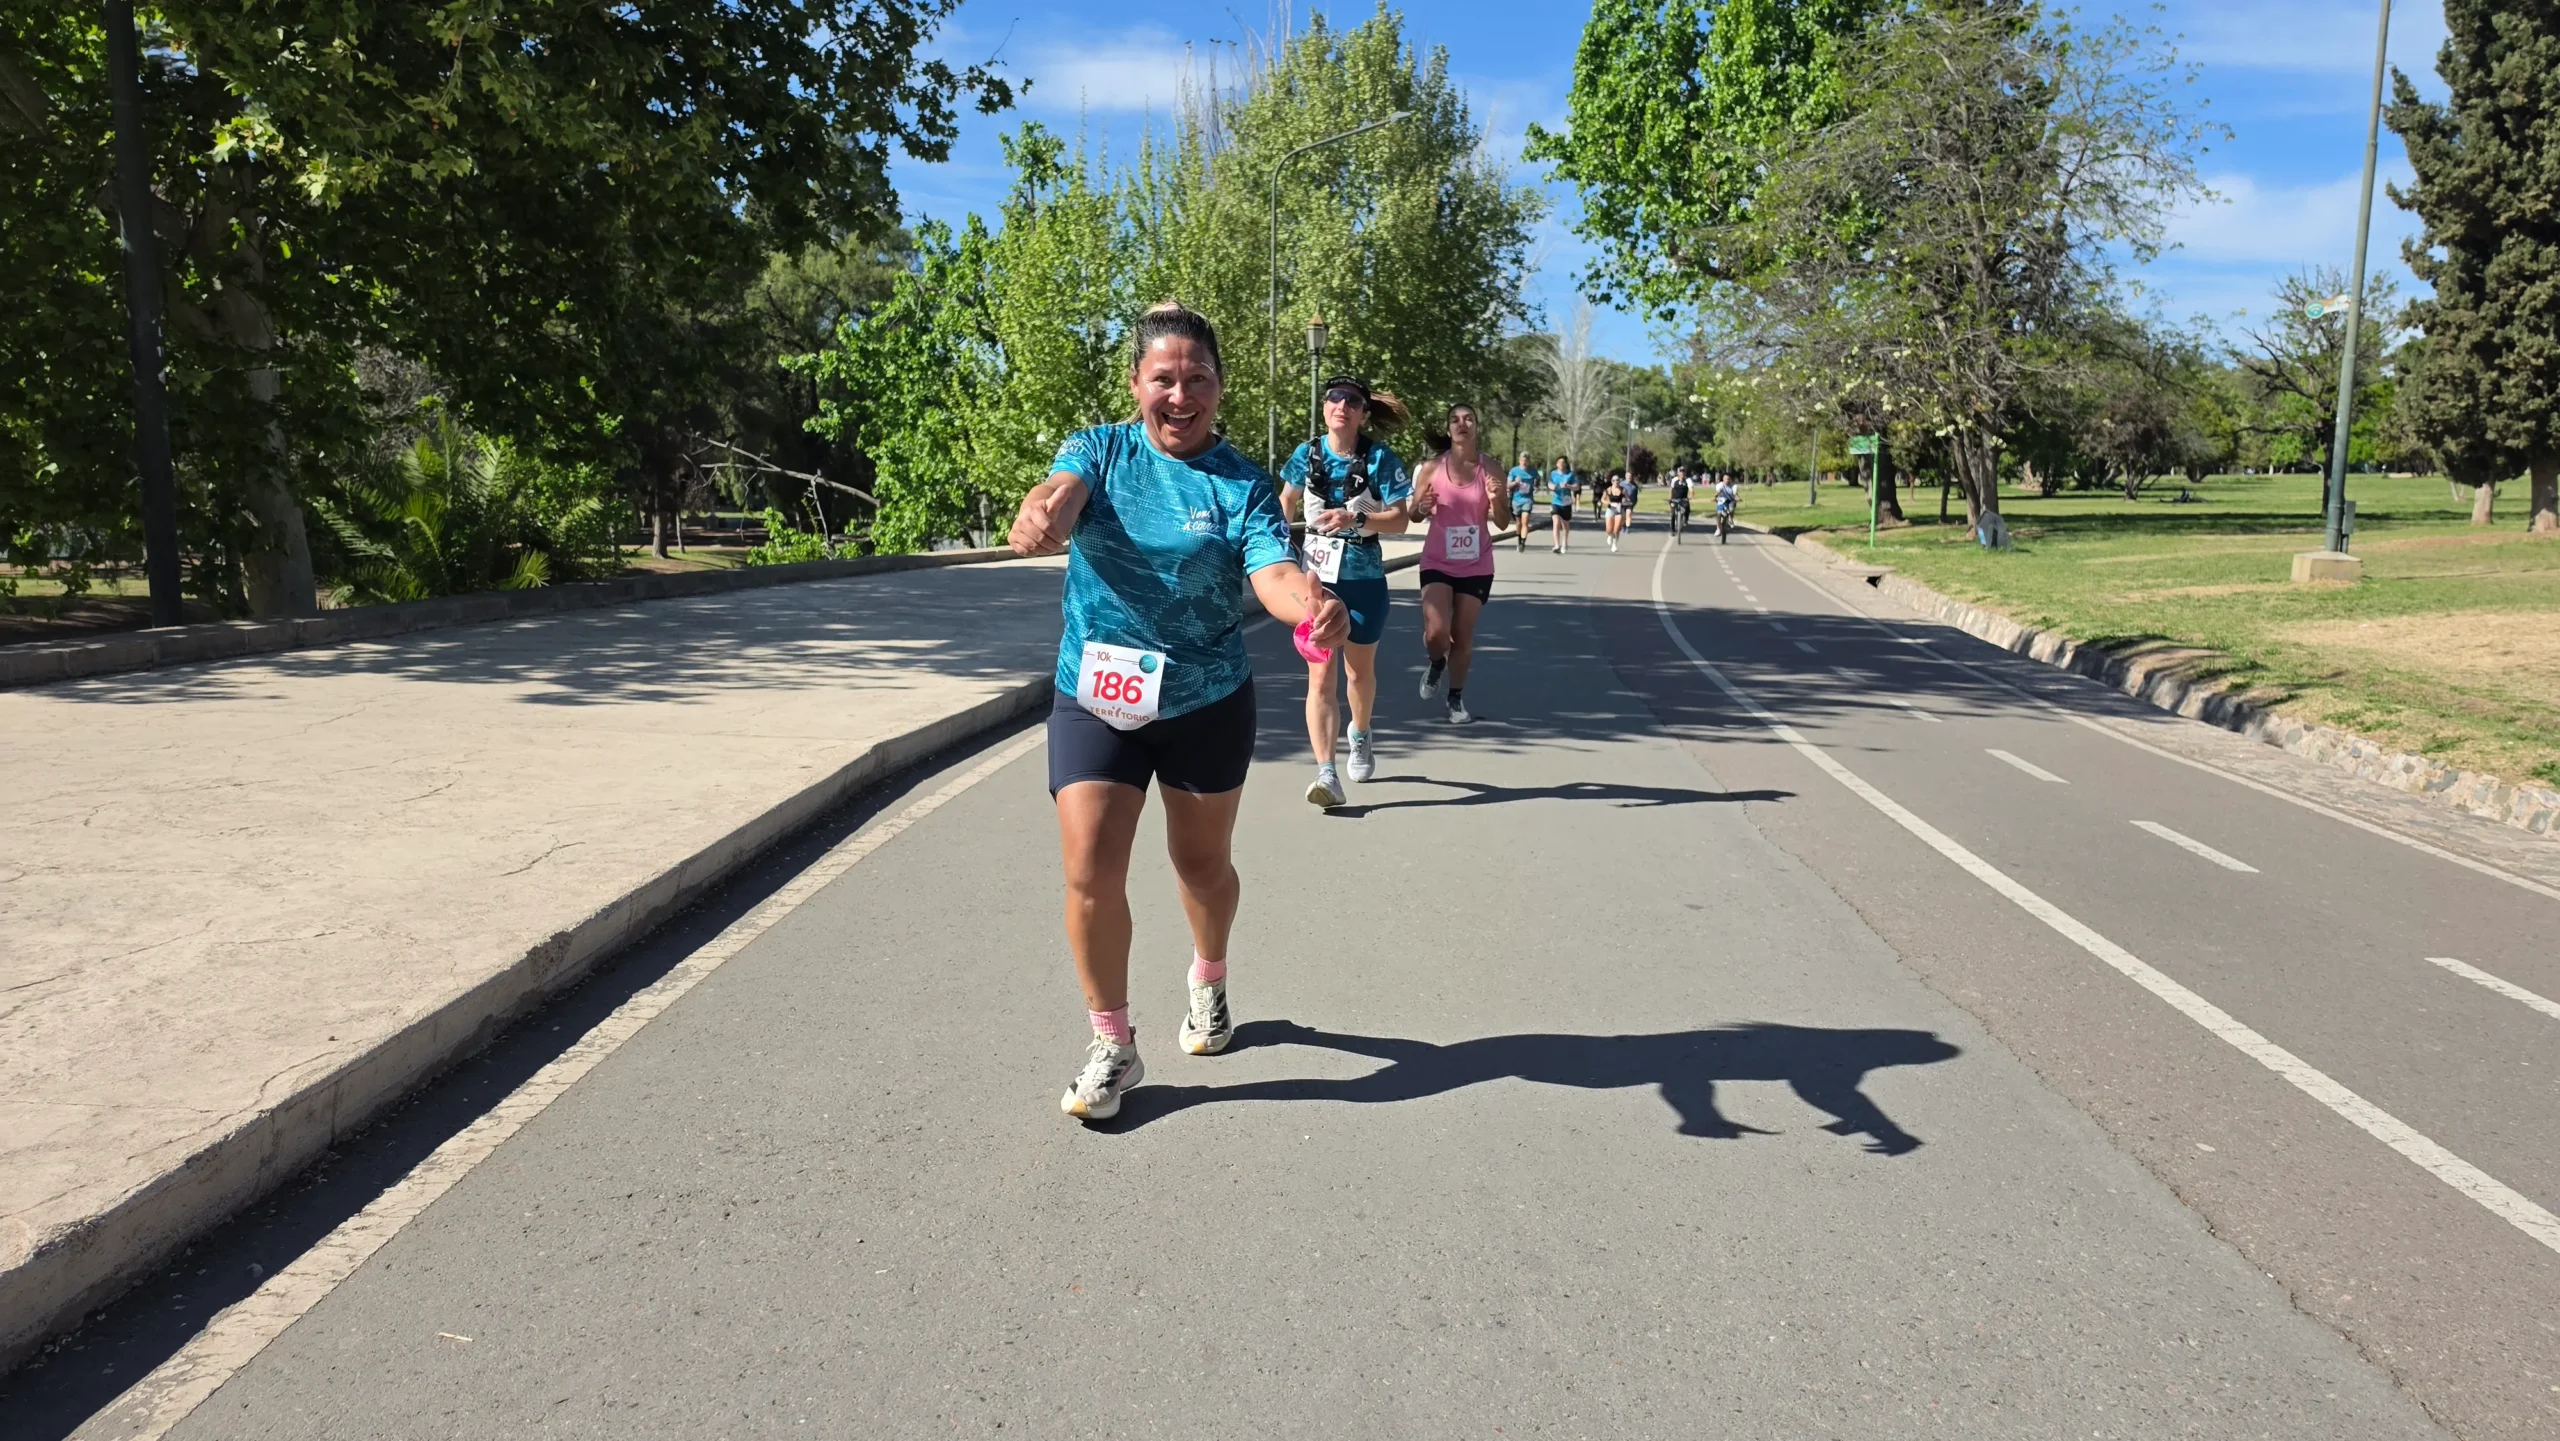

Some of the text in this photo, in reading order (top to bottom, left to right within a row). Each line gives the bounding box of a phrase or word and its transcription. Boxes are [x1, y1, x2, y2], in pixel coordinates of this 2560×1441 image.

[1451, 536, 1473, 548] 210
[1312, 549, 1331, 566] 191
[1097, 651, 1112, 662] 10k
[1093, 670, 1144, 704] 186
